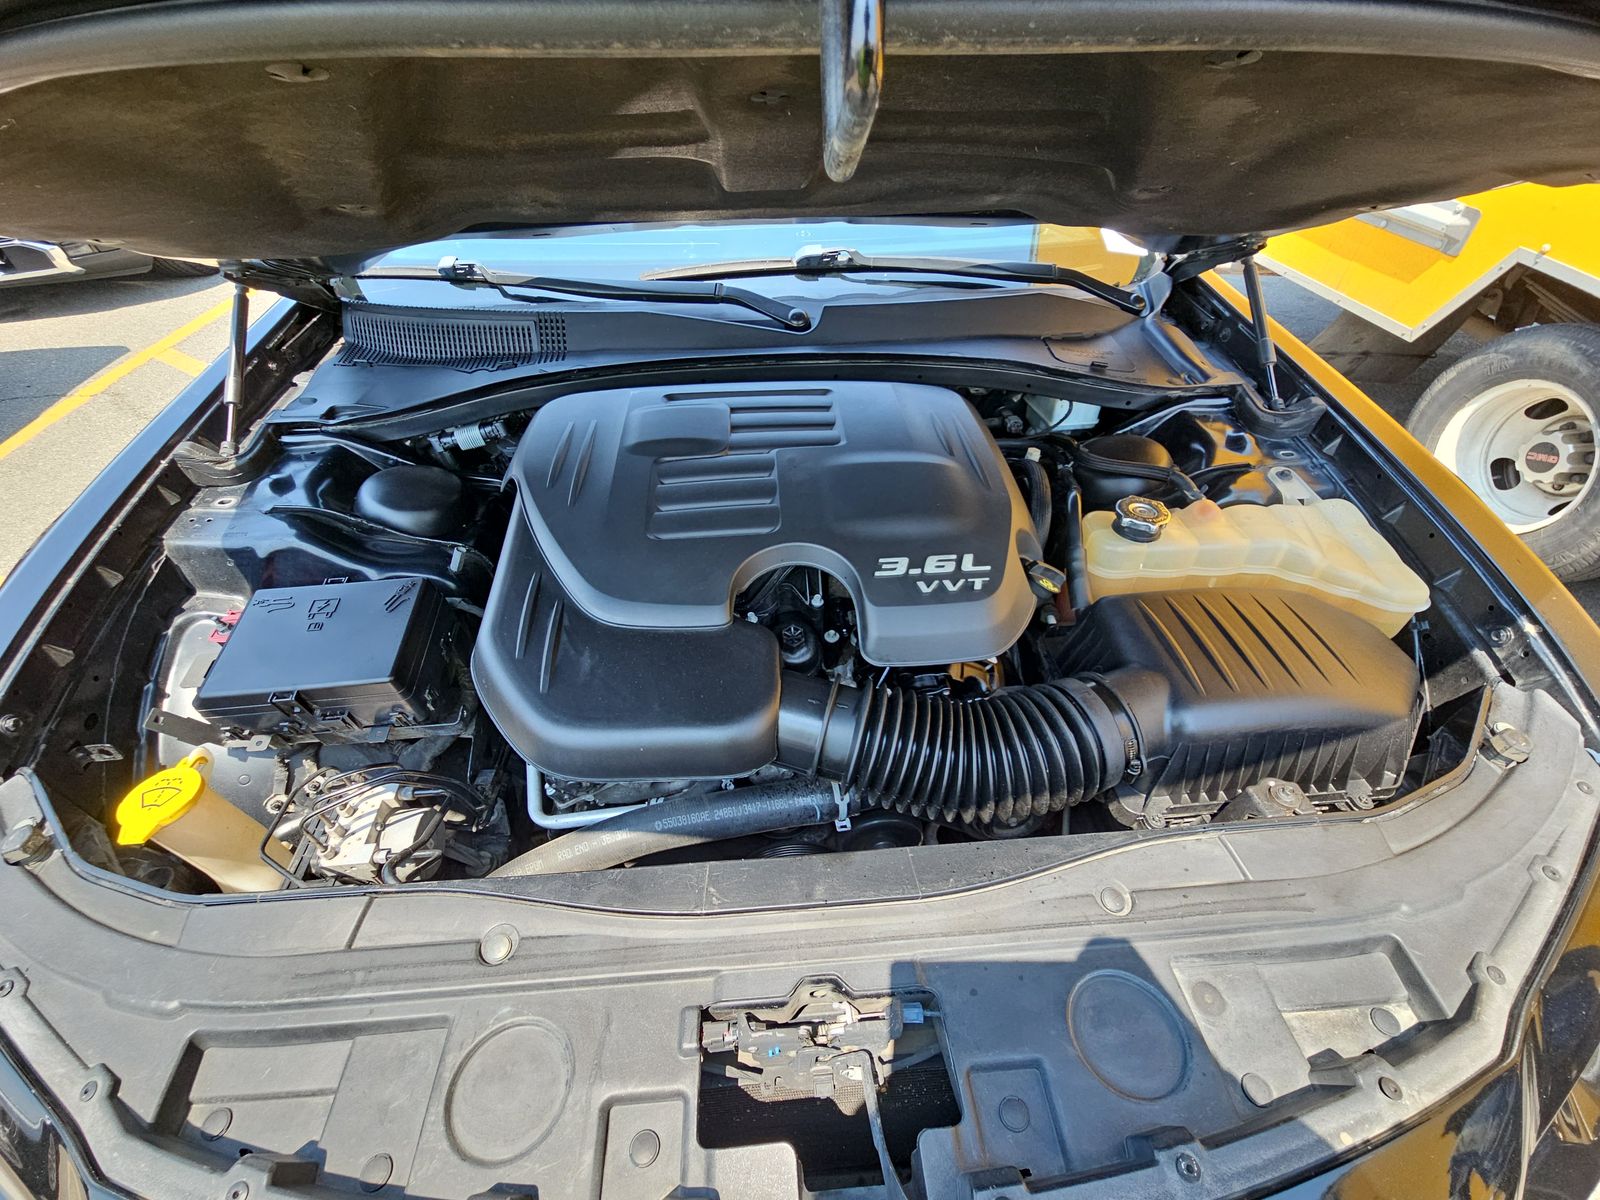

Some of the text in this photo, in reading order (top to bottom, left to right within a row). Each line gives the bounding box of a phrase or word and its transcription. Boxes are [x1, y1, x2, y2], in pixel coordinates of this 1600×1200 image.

[873, 553, 992, 577] 3.6L
[915, 577, 991, 594] VVT
[661, 810, 711, 829] 55038160AE
